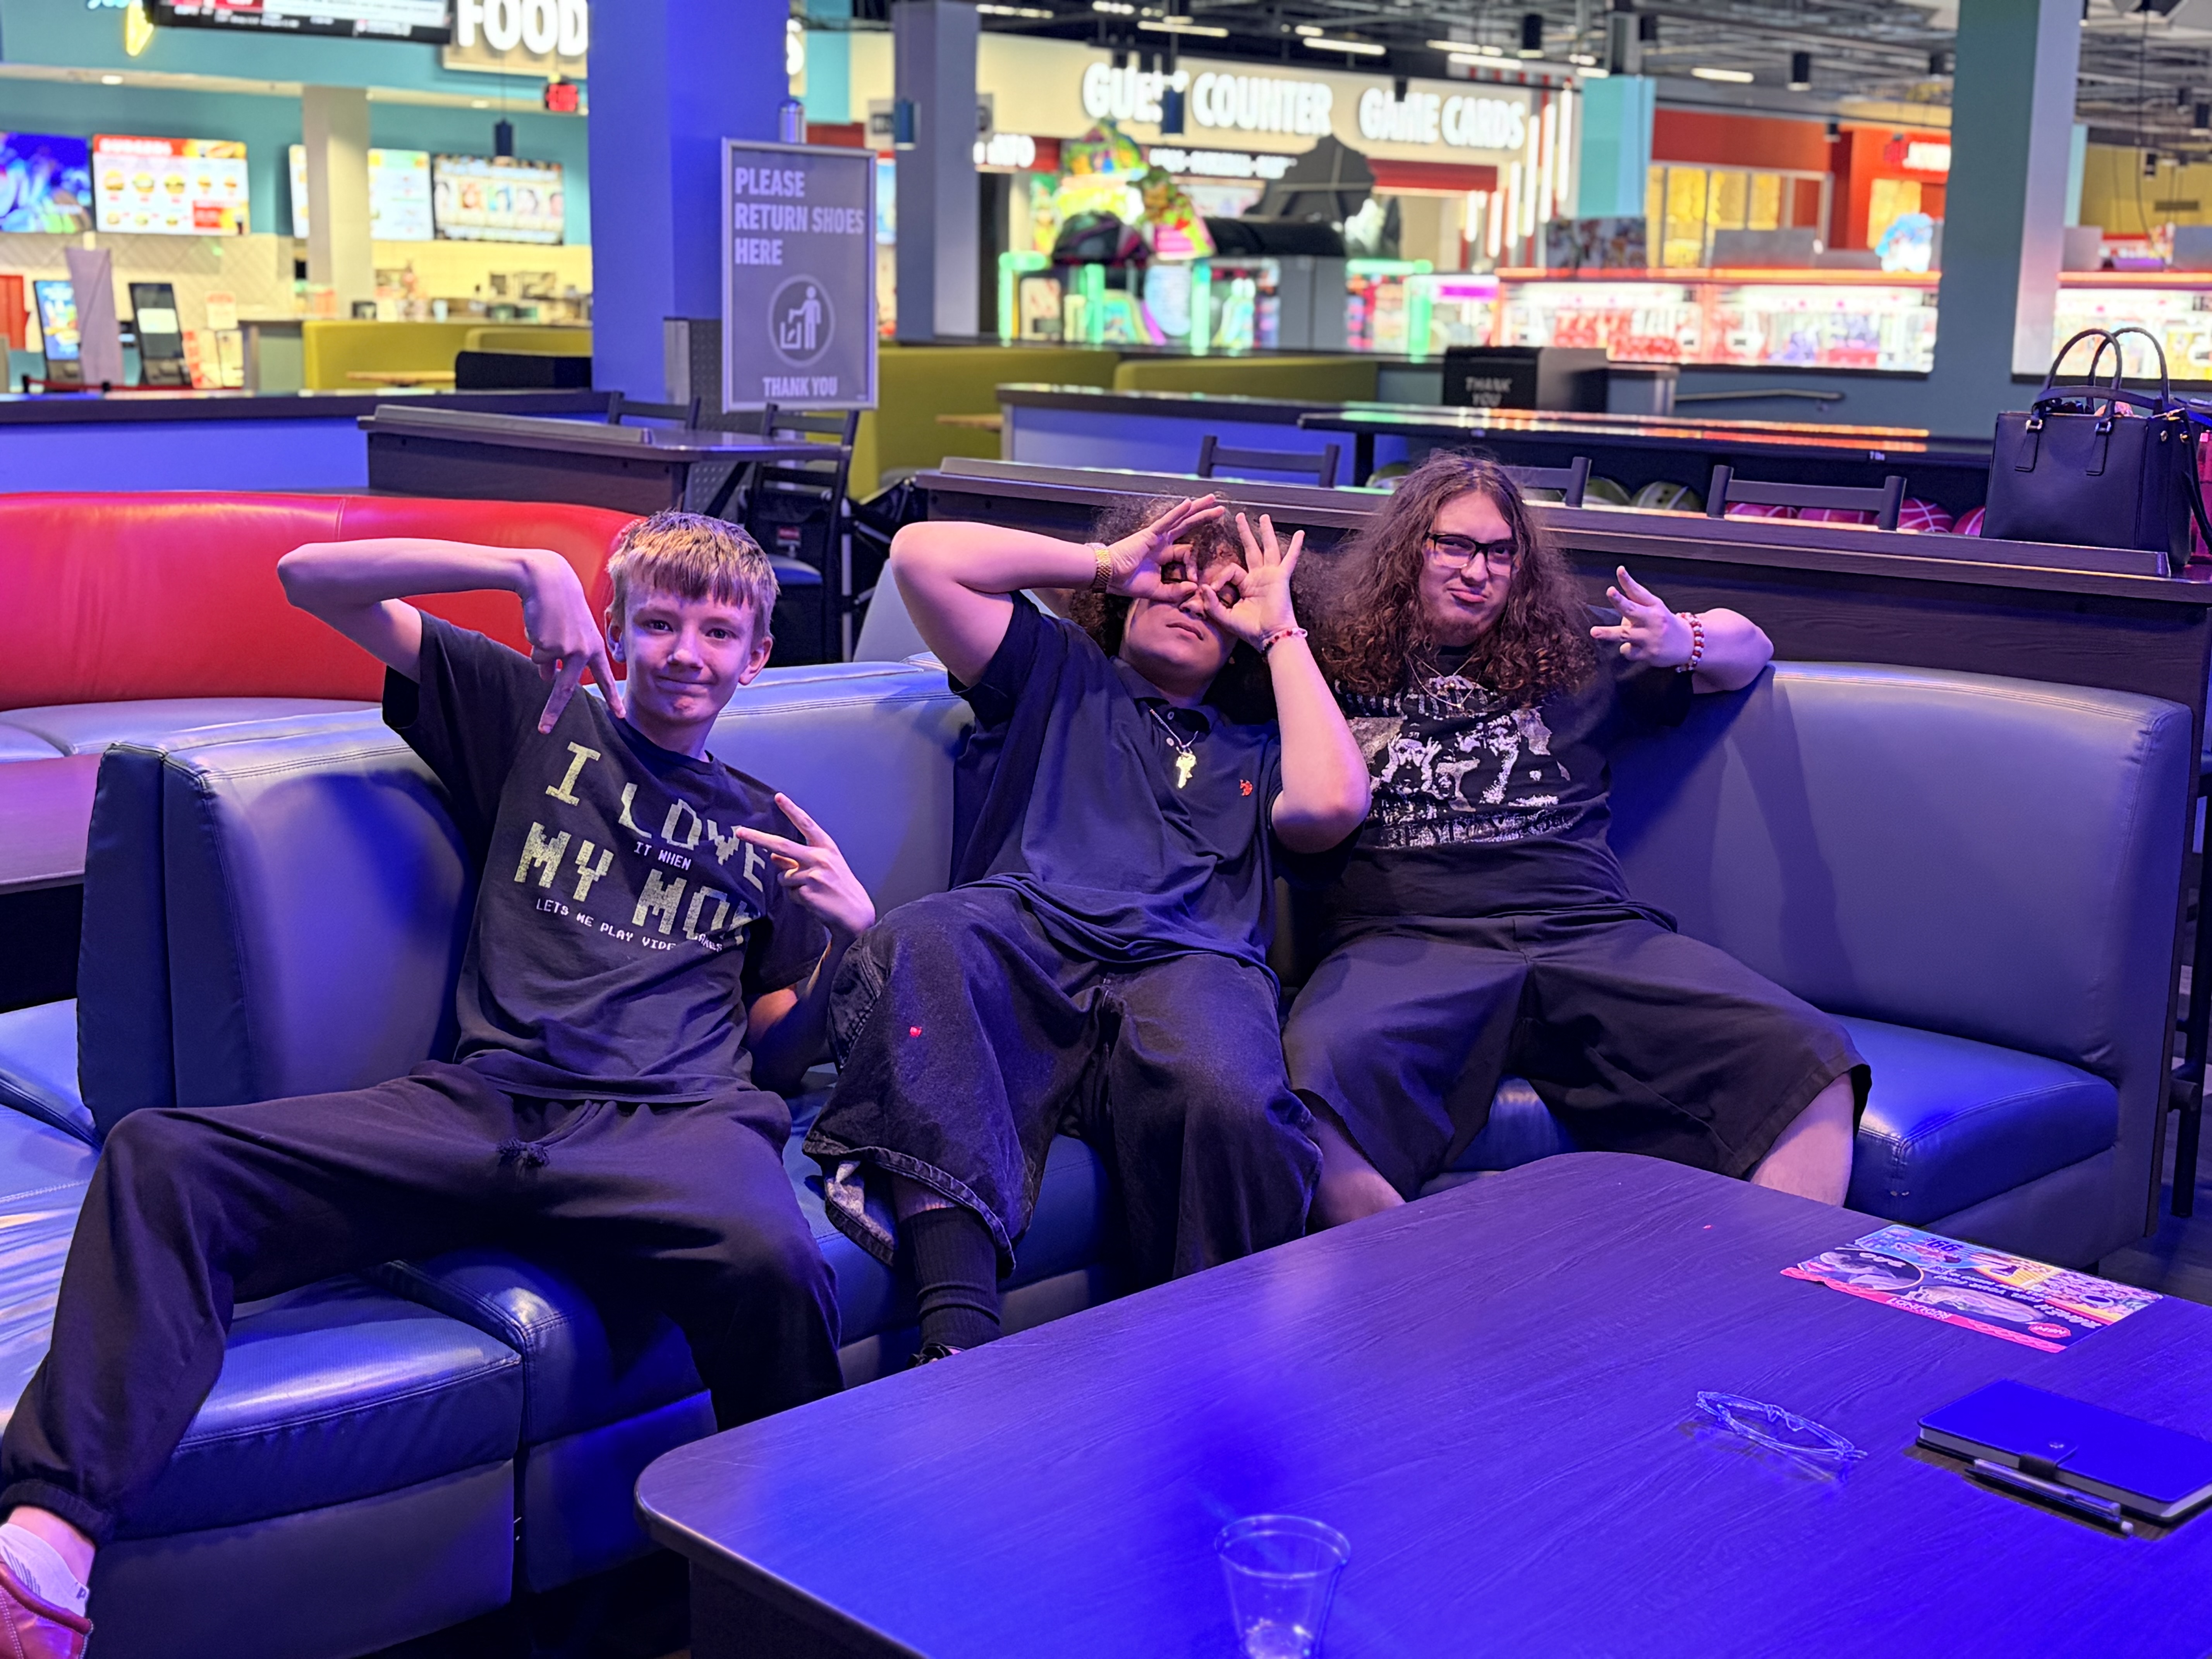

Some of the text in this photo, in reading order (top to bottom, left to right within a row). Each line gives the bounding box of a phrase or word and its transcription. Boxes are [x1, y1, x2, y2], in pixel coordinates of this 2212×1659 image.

[458, 0, 588, 56] FOOD
[1192, 72, 1333, 136] COUNTER
[1441, 95, 1525, 149] CARDS
[736, 167, 805, 198] PLEASE
[735, 203, 865, 234] RETURN SHOES
[735, 237, 783, 266] HERE
[763, 376, 838, 397] THANK YOU
[1465, 377, 1512, 392] THANK
[1472, 393, 1502, 407] YOU
[545, 742, 766, 892] I LOVE
[514, 821, 614, 902] MY
[634, 841, 691, 871] IT WHEN
[536, 898, 569, 916] LETS
[576, 912, 594, 927] ME
[600, 922, 634, 942] PLAY
